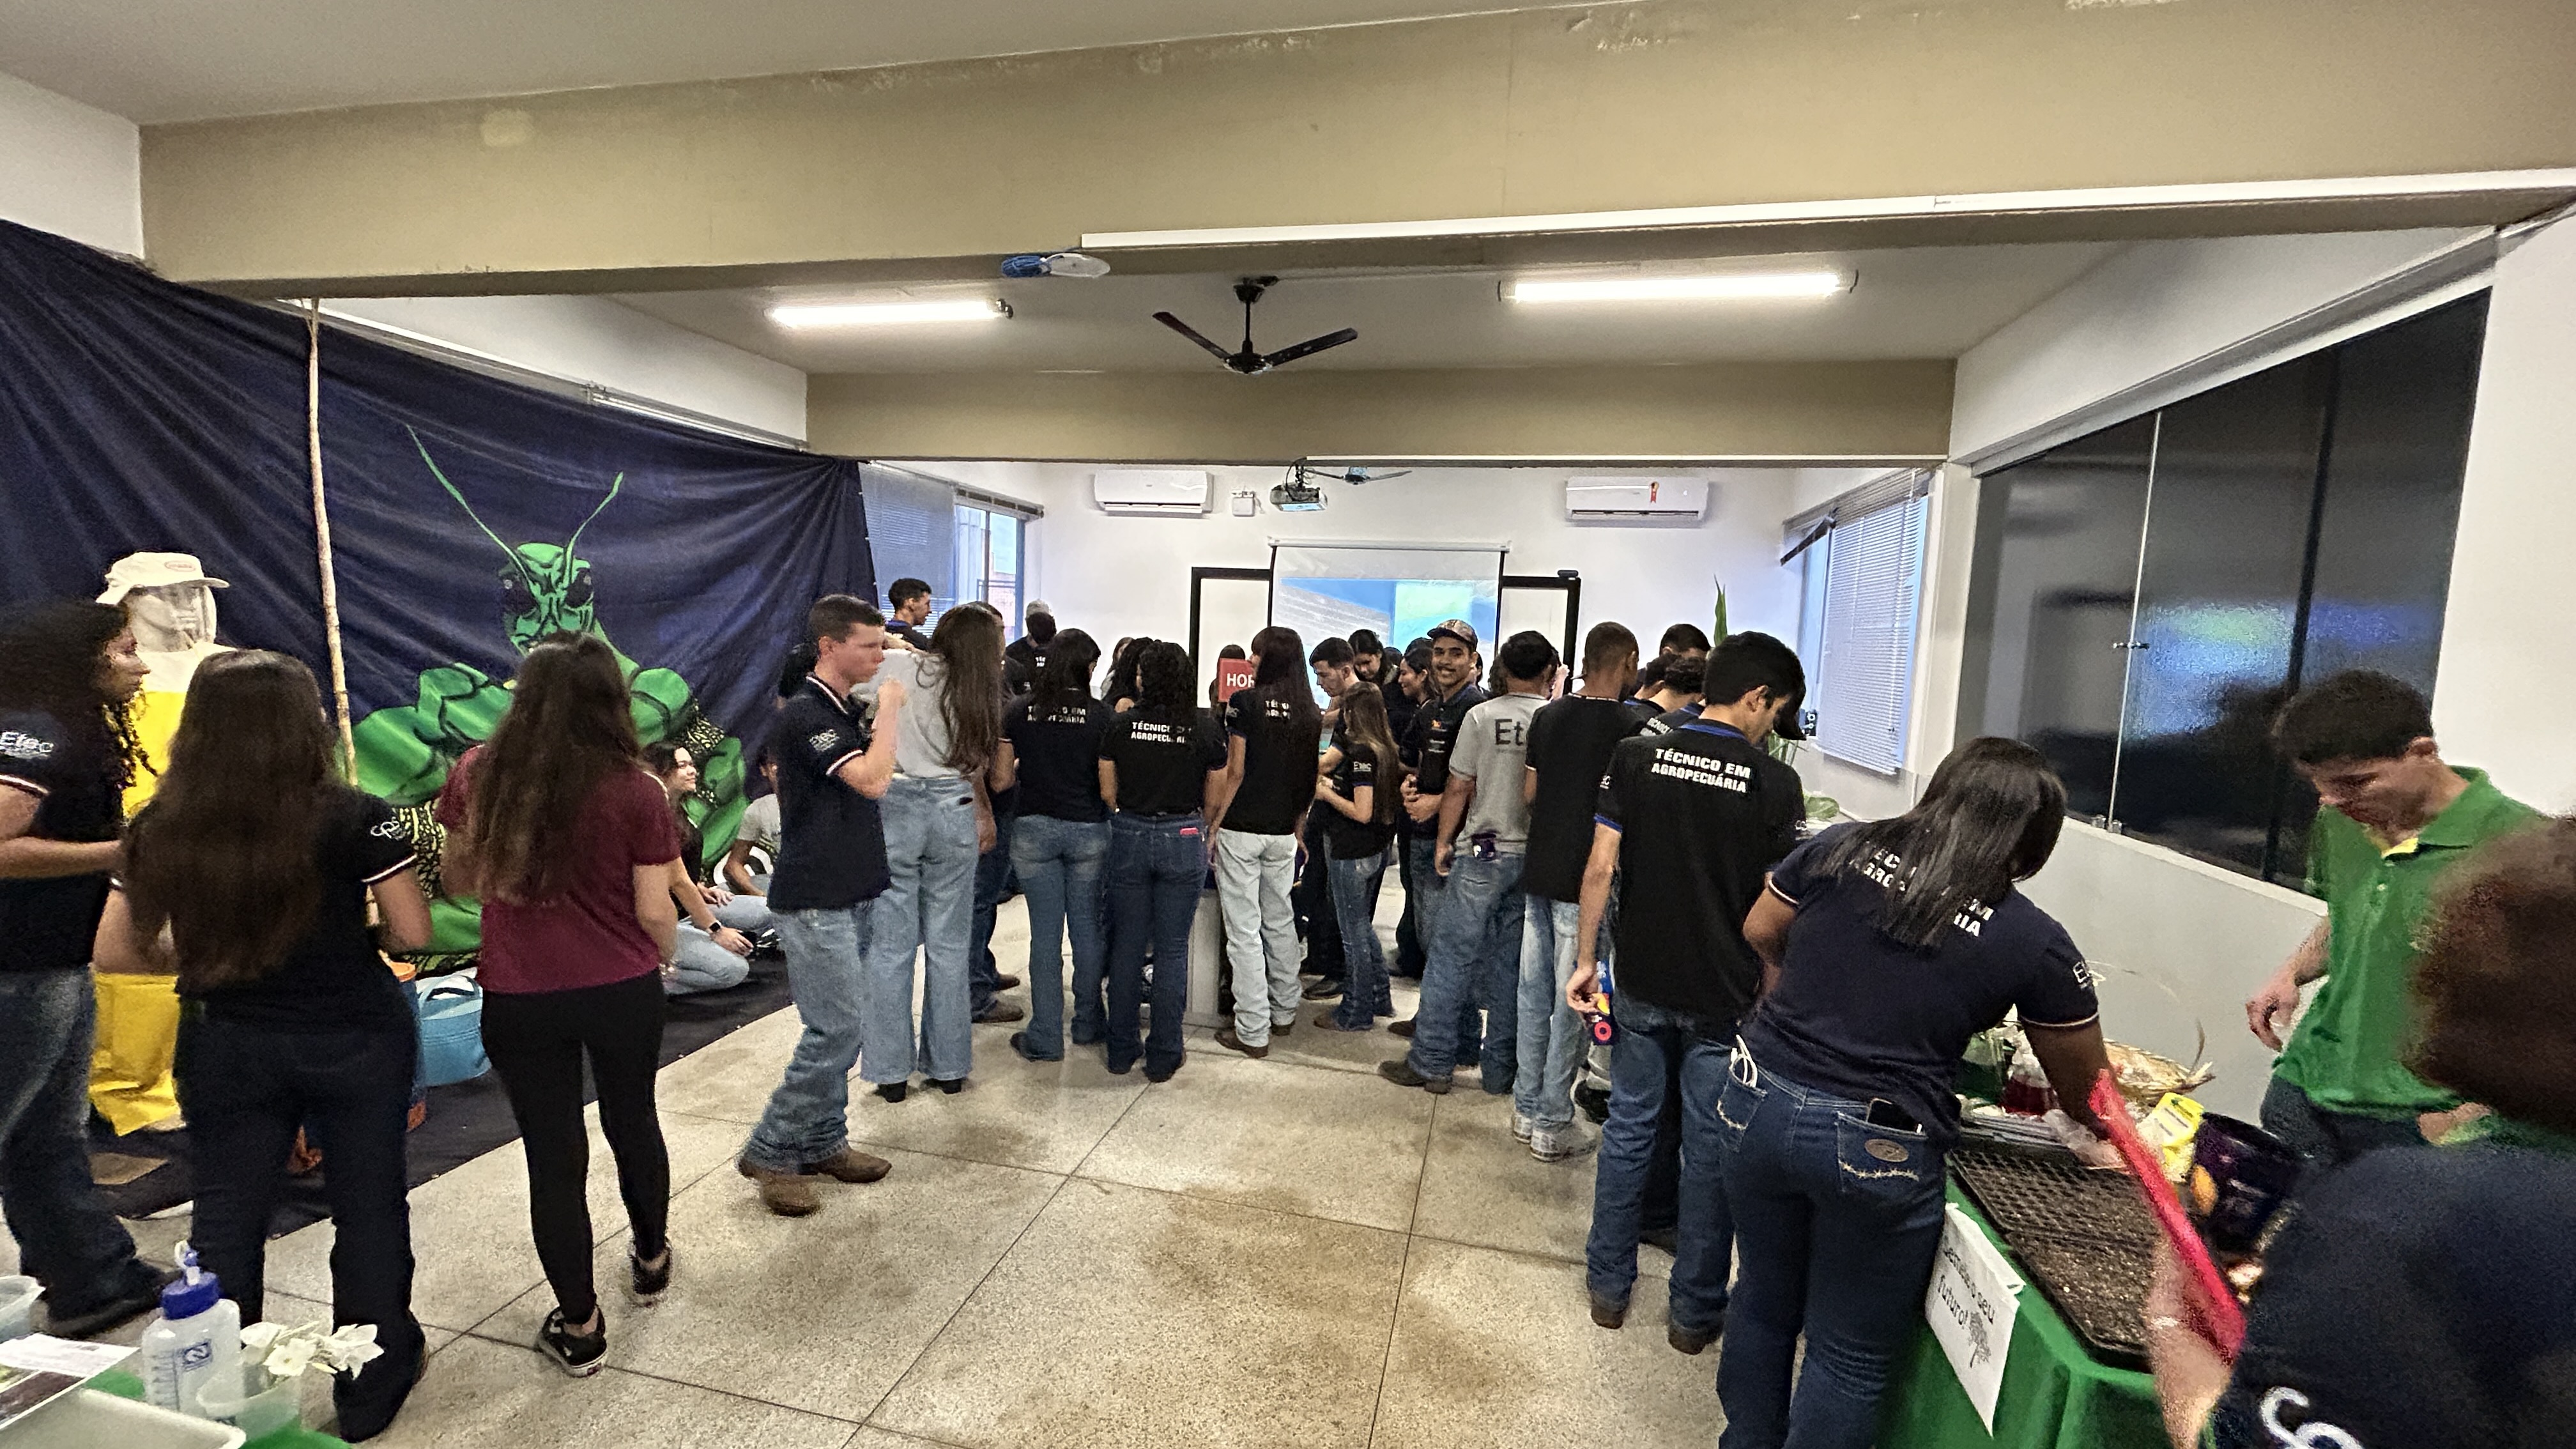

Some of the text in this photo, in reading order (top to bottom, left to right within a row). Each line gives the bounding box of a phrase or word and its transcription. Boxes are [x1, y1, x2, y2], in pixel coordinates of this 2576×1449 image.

[1651, 762, 1747, 793] AGROPECUÁRIA
[1655, 748, 1752, 779] TÉCNICO EM
[1938, 1274, 1968, 1330] futuro!
[1977, 1291, 1995, 1325] seu
